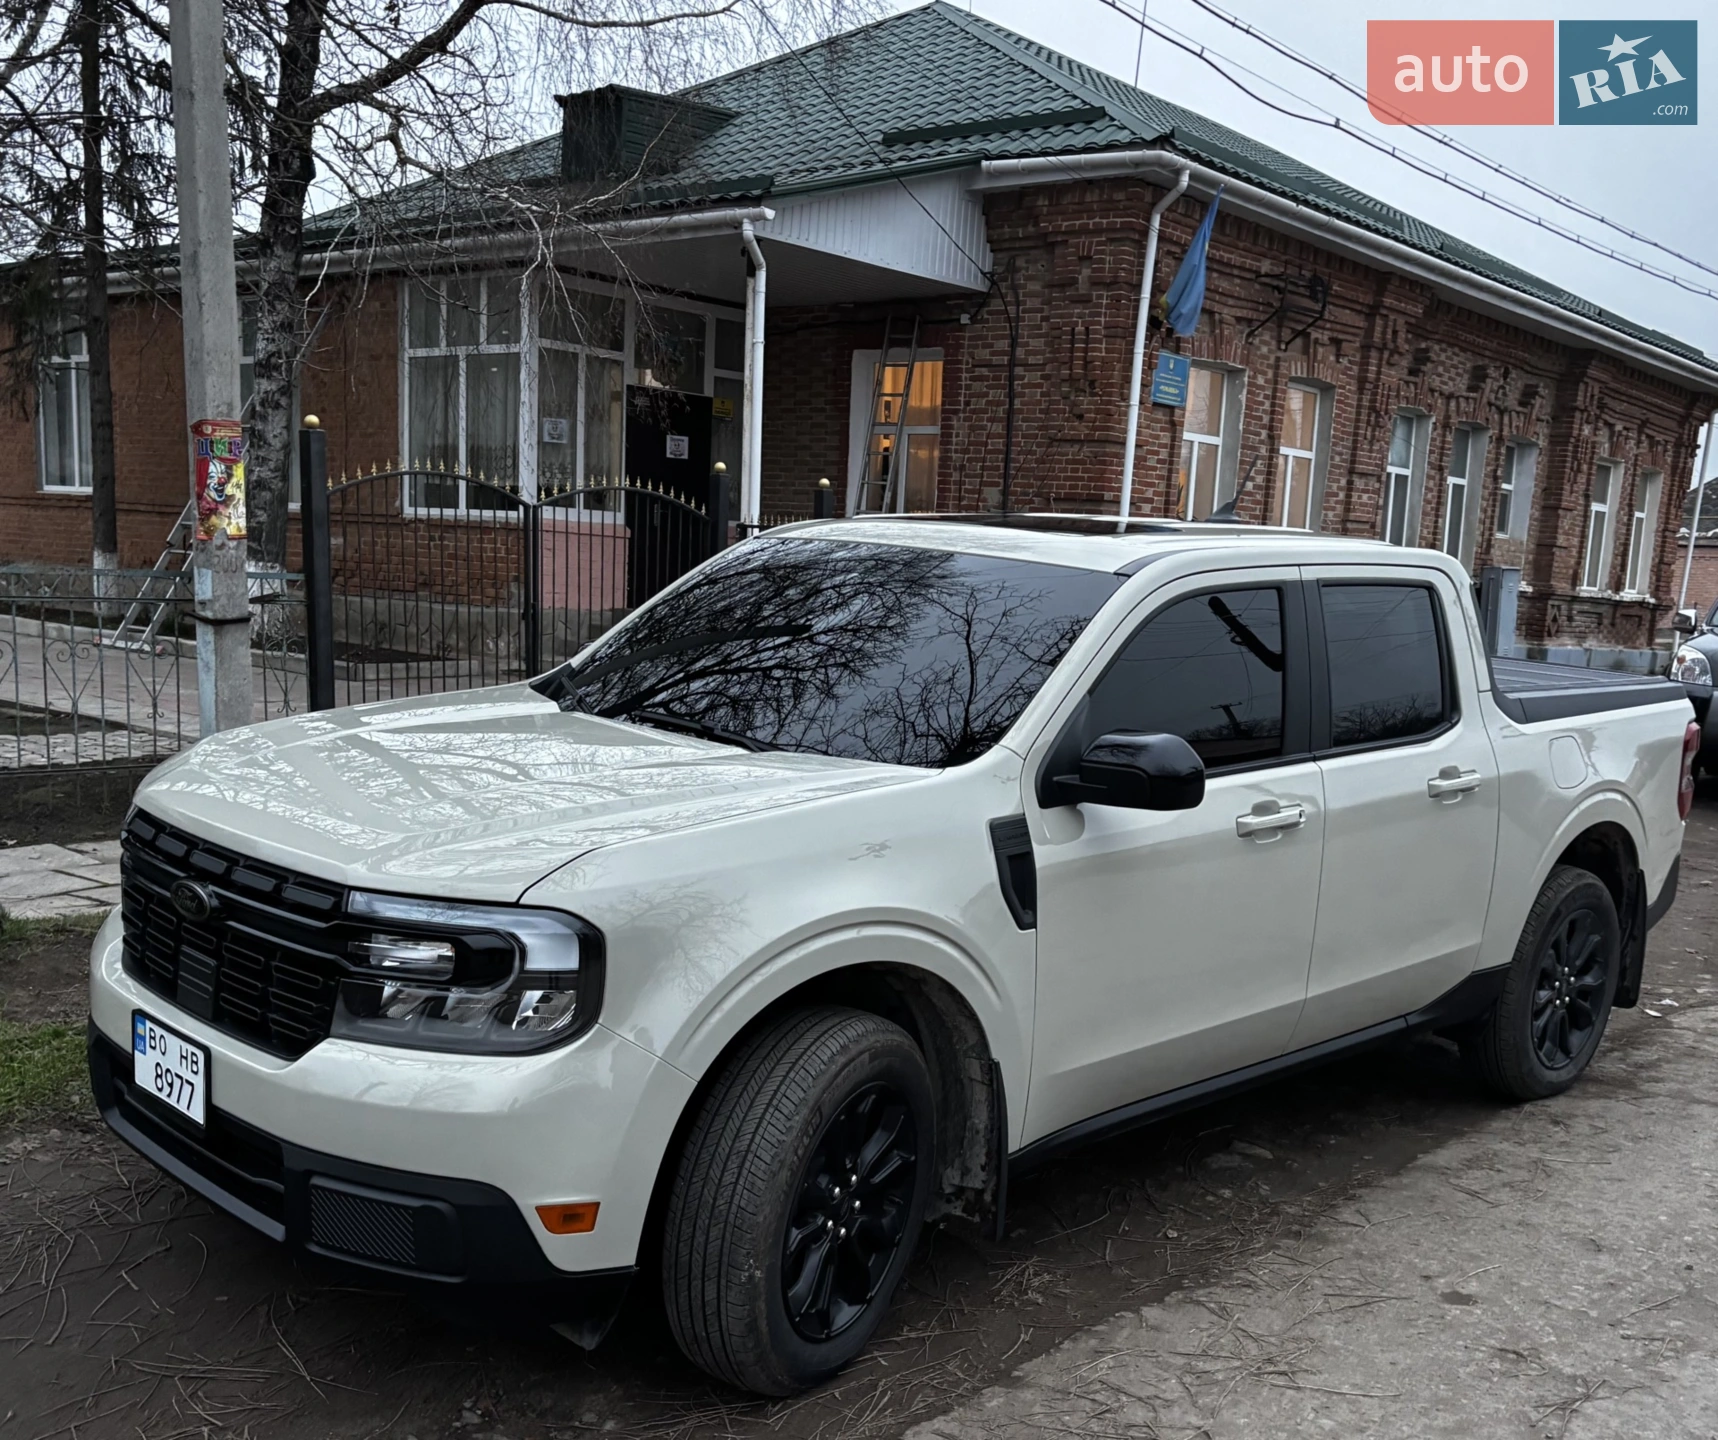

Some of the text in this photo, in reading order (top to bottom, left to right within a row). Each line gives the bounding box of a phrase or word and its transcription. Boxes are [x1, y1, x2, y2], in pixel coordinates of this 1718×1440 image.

[174, 886, 199, 913] Ford
[136, 1037, 145, 1053] UA
[154, 1061, 195, 1111] 8977
